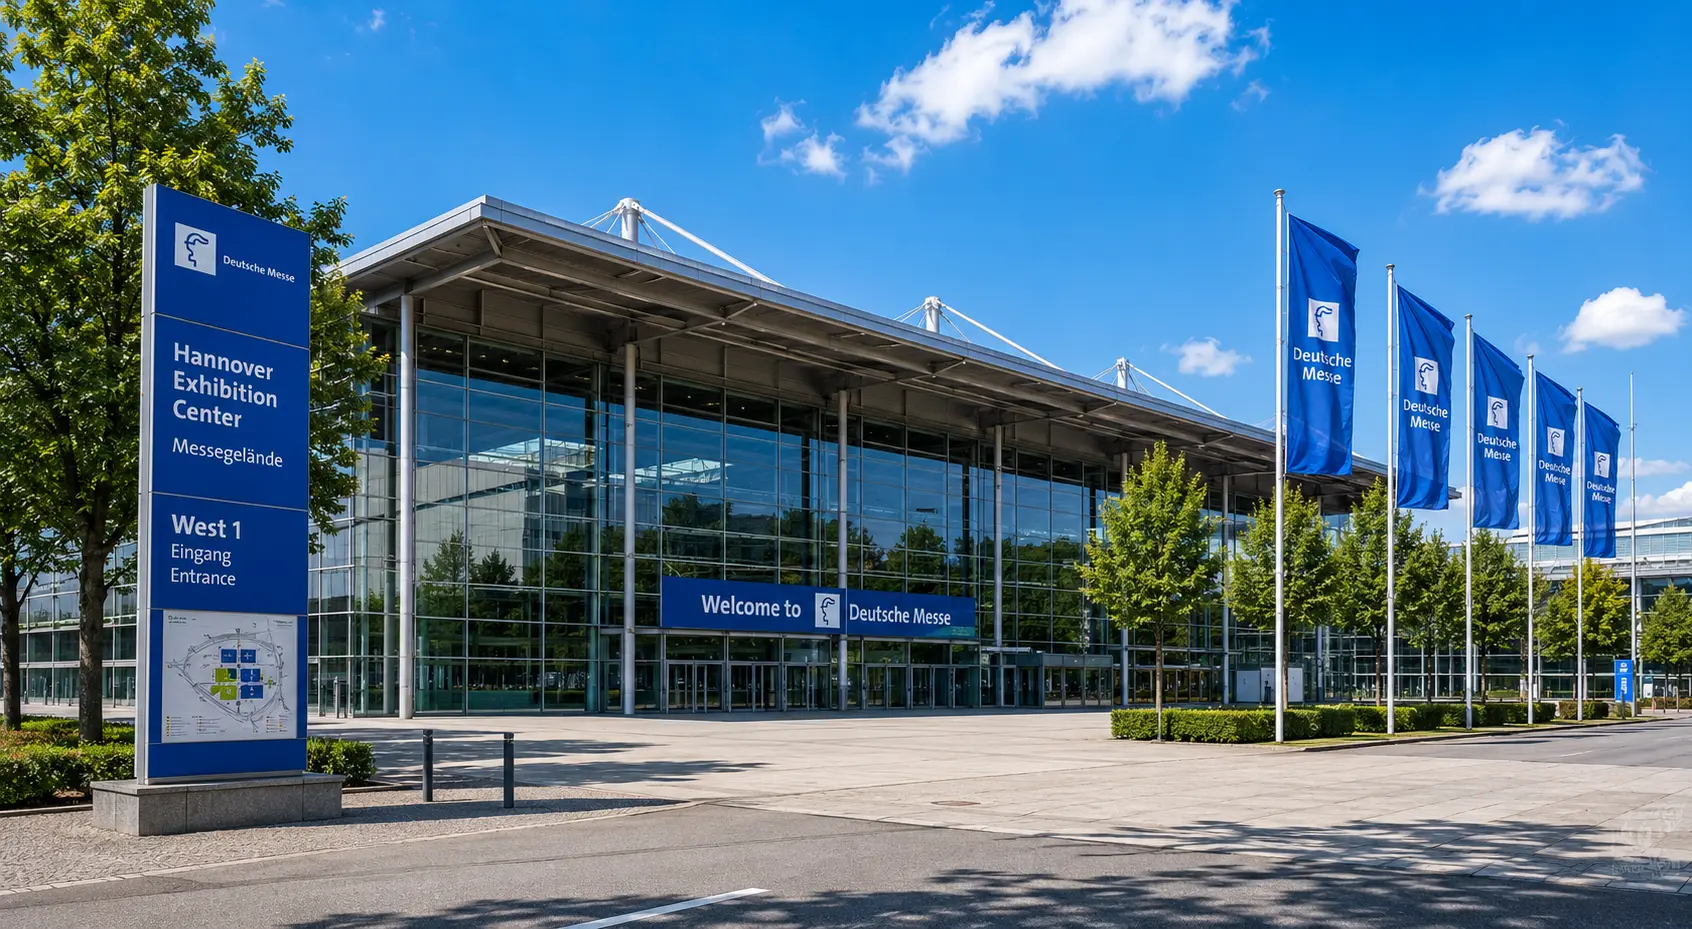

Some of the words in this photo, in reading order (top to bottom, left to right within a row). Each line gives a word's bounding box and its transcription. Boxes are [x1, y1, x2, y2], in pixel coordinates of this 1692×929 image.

[224, 256, 265, 274] Deutsche
[268, 268, 294, 282] Messe
[174, 342, 273, 380] Hannover
[1293, 347, 1352, 368] Deutsche
[1302, 366, 1342, 385] Messe
[174, 370, 277, 408] Exhibition
[174, 400, 241, 427] Center
[1403, 398, 1449, 419] Deutsche
[173, 438, 282, 467] Messegelände
[1477, 432, 1517, 450] Deutsche
[172, 514, 226, 537] West
[233, 522, 240, 539] 1
[172, 544, 231, 566] Eingang
[172, 568, 235, 585] Entrance
[702, 595, 779, 616] Welcome
[784, 600, 801, 617] to
[850, 604, 909, 623] Deutsche
[914, 608, 950, 625] Messe
